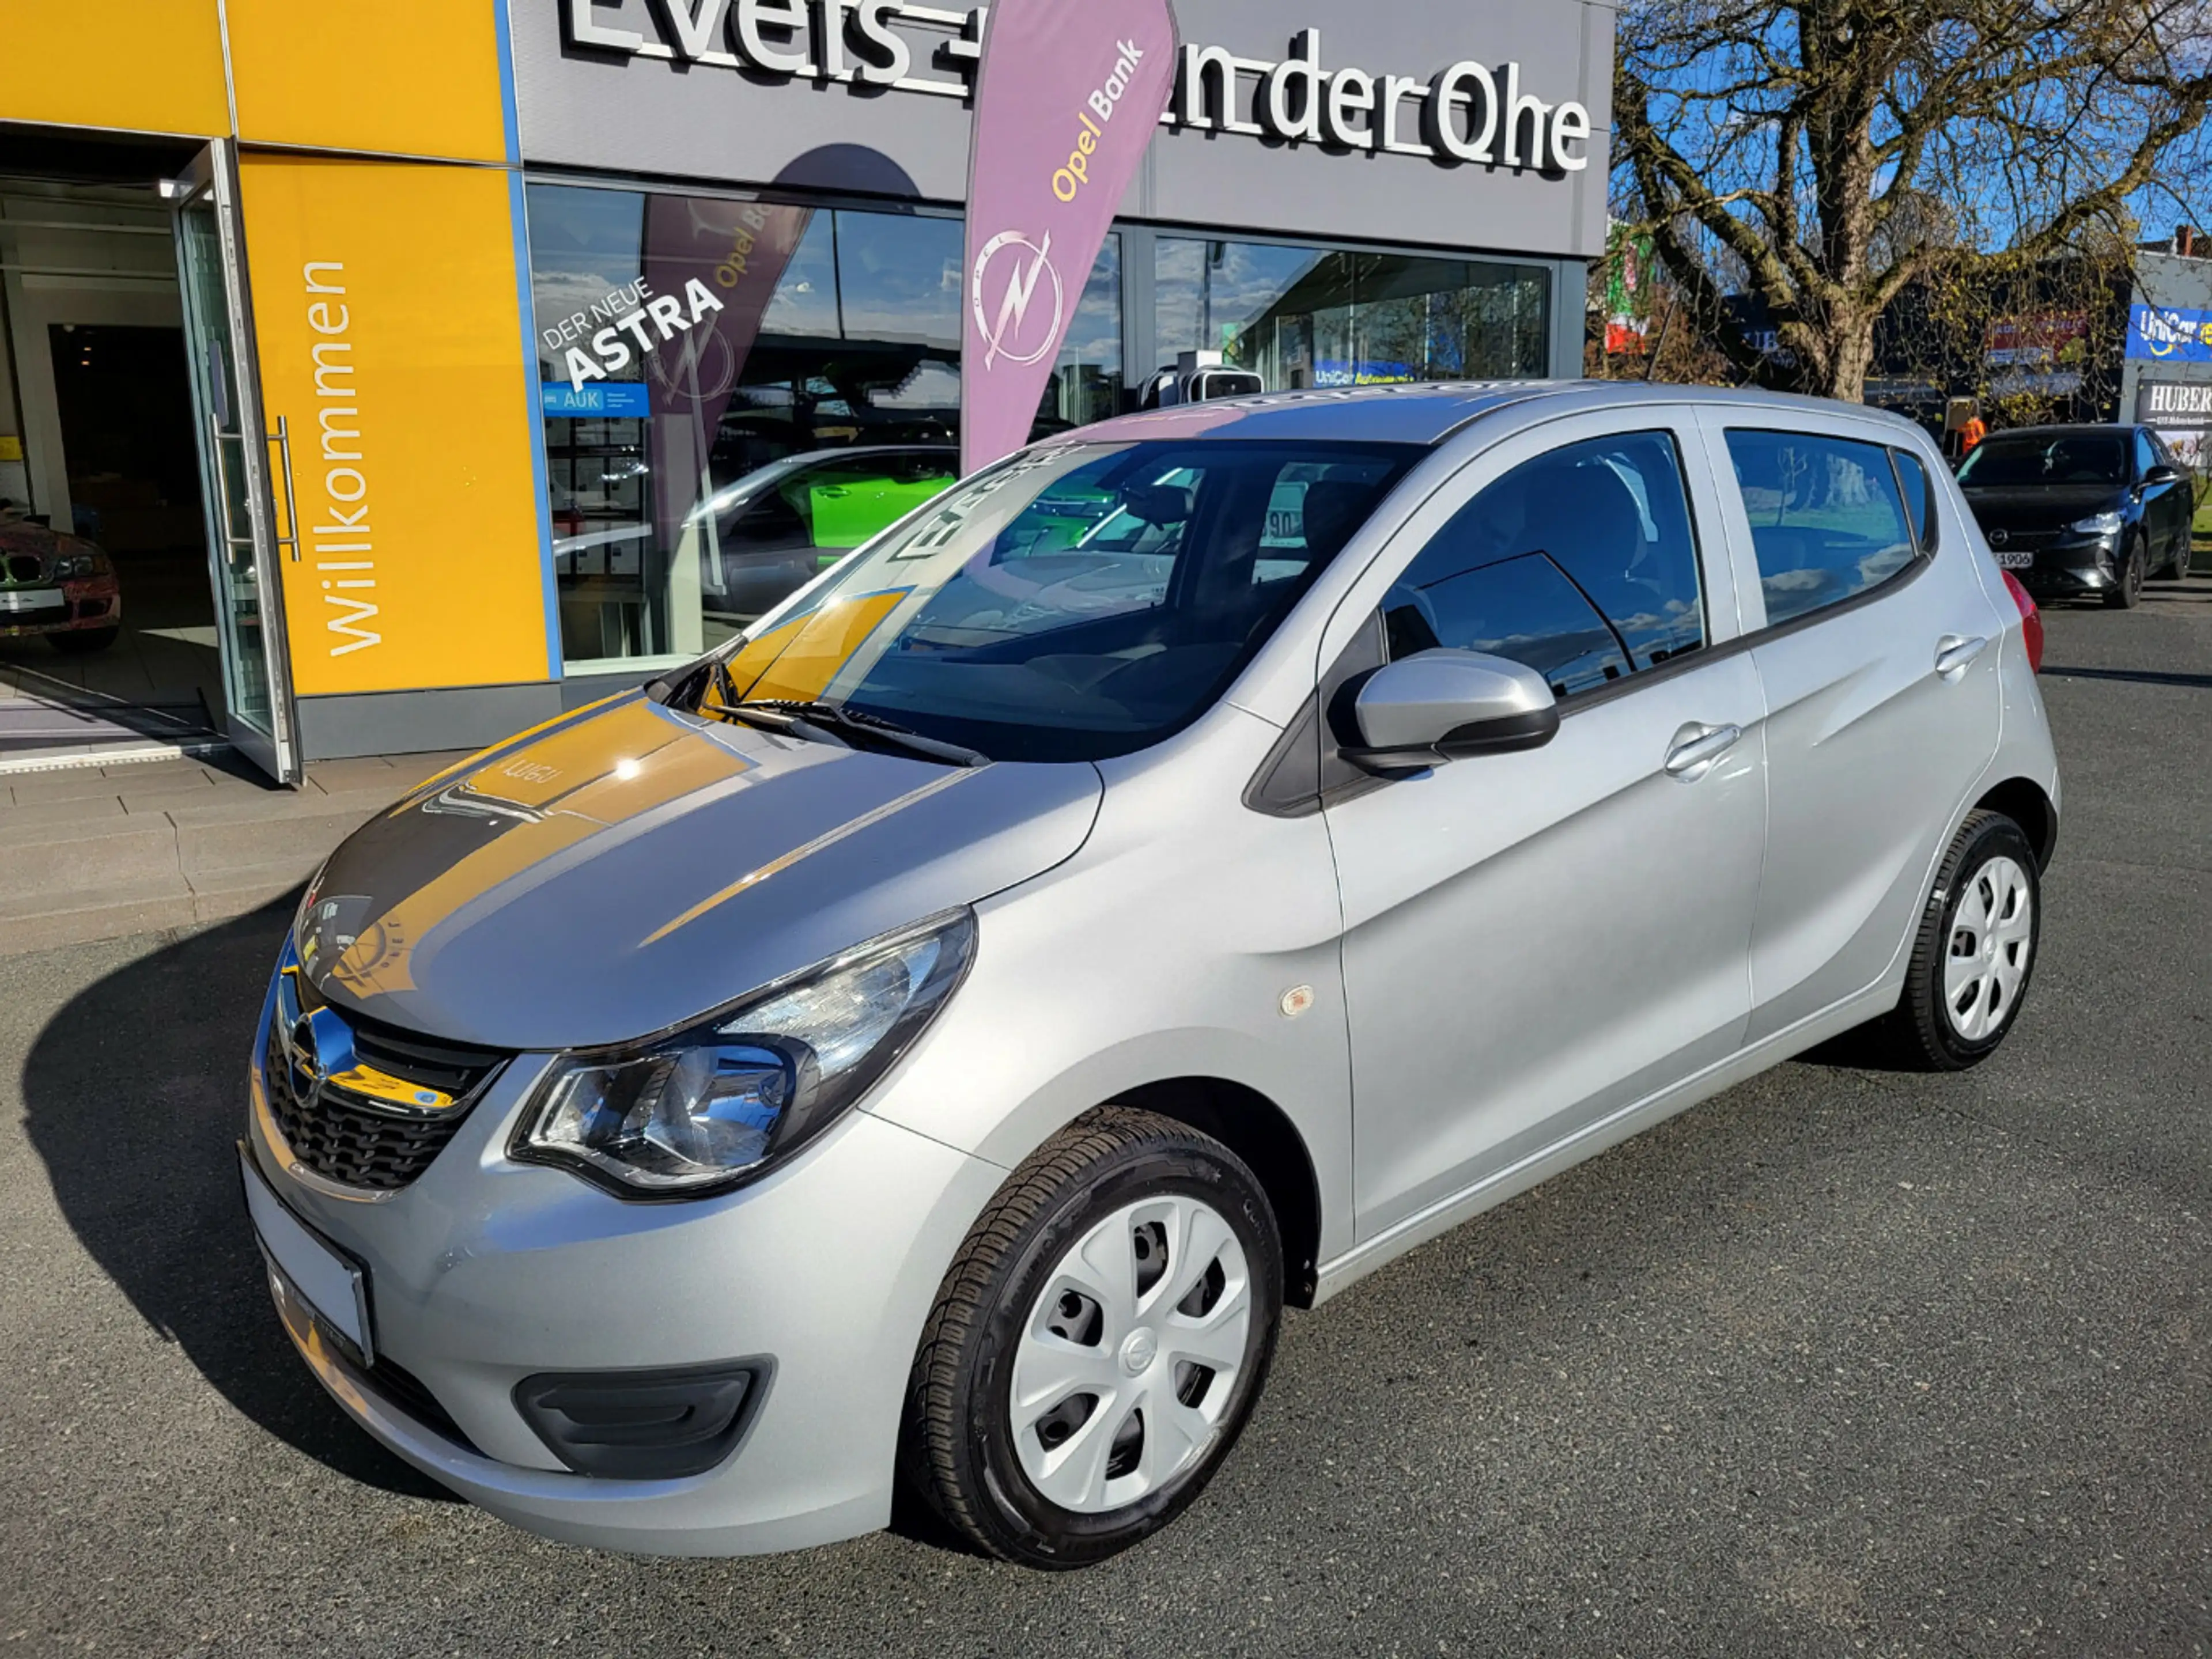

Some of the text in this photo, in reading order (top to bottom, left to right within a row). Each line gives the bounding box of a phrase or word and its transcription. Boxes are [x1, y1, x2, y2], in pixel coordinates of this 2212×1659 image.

[1052, 38, 1144, 202] Opel Bank
[1269, 28, 1415, 150] der
[1437, 60, 1591, 171] Ohe
[542, 275, 654, 350] DER NEUE
[565, 277, 724, 393] ASTRA
[2141, 310, 2197, 343] UniCar
[564, 391, 599, 408] AUK
[2150, 385, 2212, 412] HUBER
[303, 262, 381, 657] Willkommen
